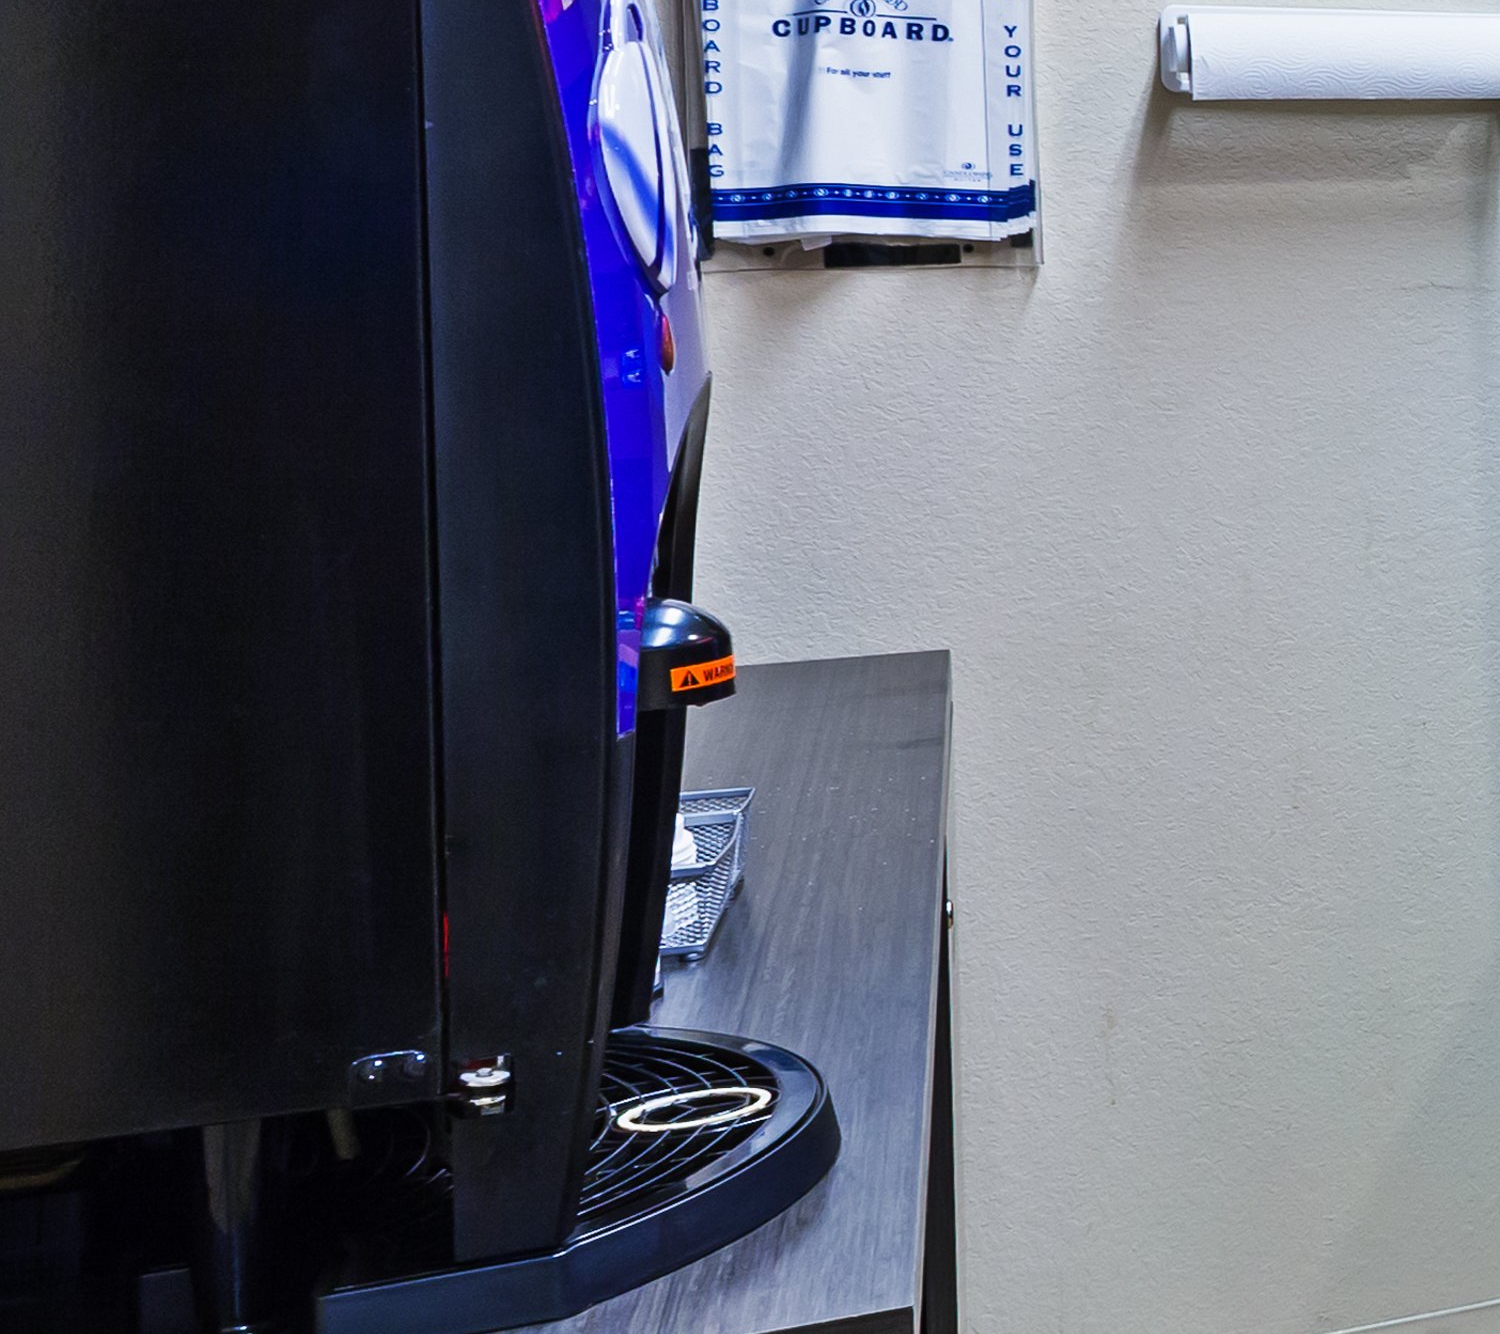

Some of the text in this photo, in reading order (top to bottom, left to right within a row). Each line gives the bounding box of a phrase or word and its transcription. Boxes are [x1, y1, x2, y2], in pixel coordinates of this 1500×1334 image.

[772, 16, 951, 42] CUPBOARD
[1003, 25, 1022, 97] YOUR
[706, 122, 725, 178] BAG
[1008, 124, 1024, 177] USE
